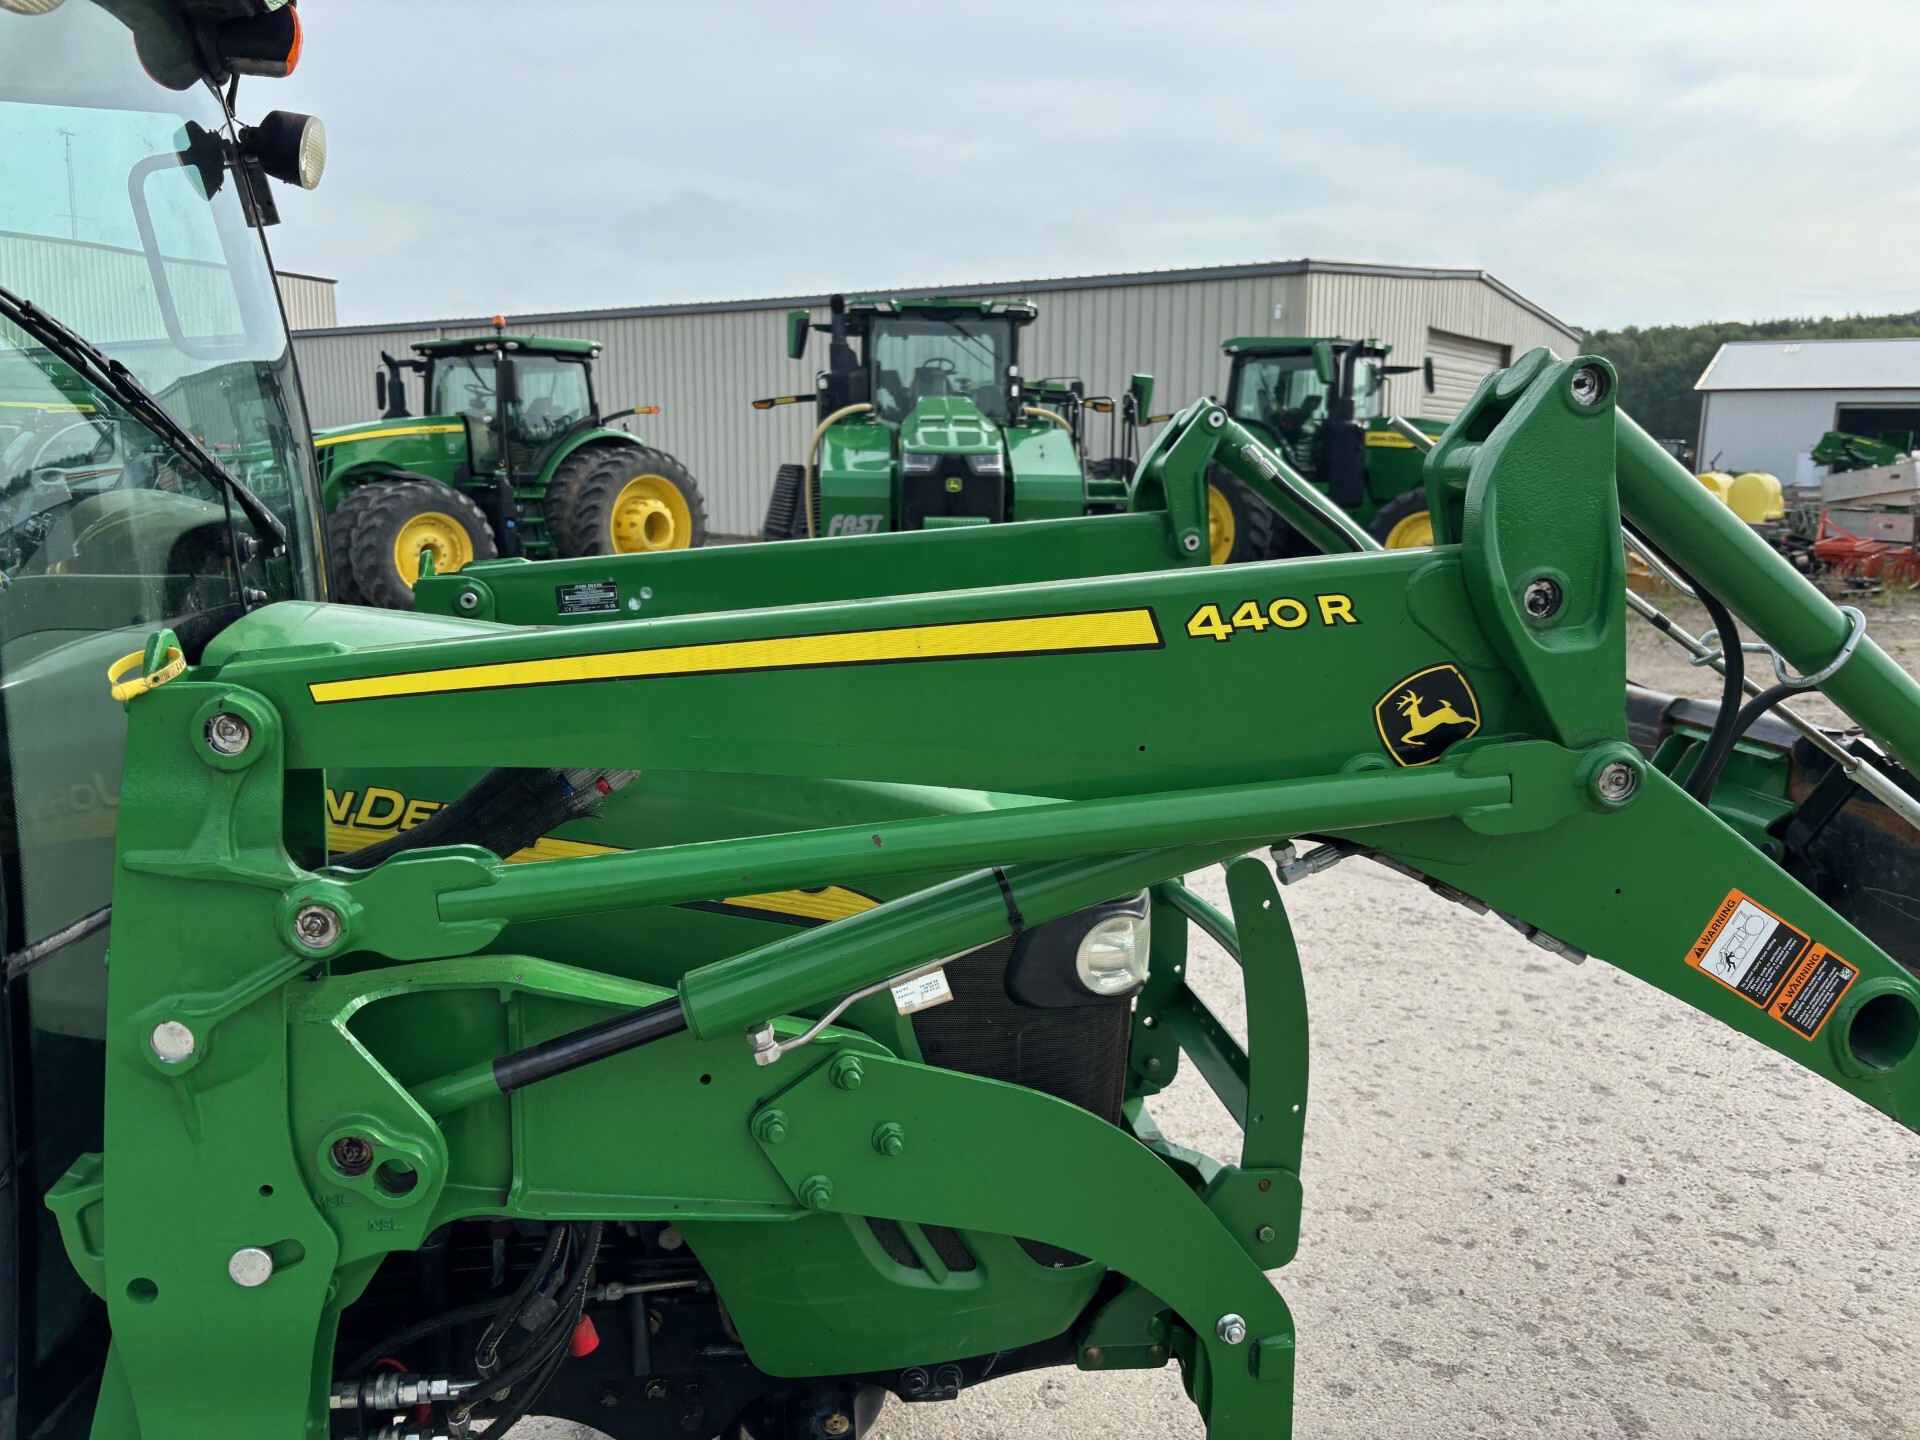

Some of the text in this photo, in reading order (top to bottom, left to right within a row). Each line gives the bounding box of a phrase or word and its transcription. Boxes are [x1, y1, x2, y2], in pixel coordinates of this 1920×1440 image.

[828, 514, 884, 537] FAST
[1186, 593, 1359, 642] 440 R
[1701, 899, 1736, 946] WARNING
[1785, 952, 1821, 998] WARNING
[368, 1217, 406, 1231] NSL
